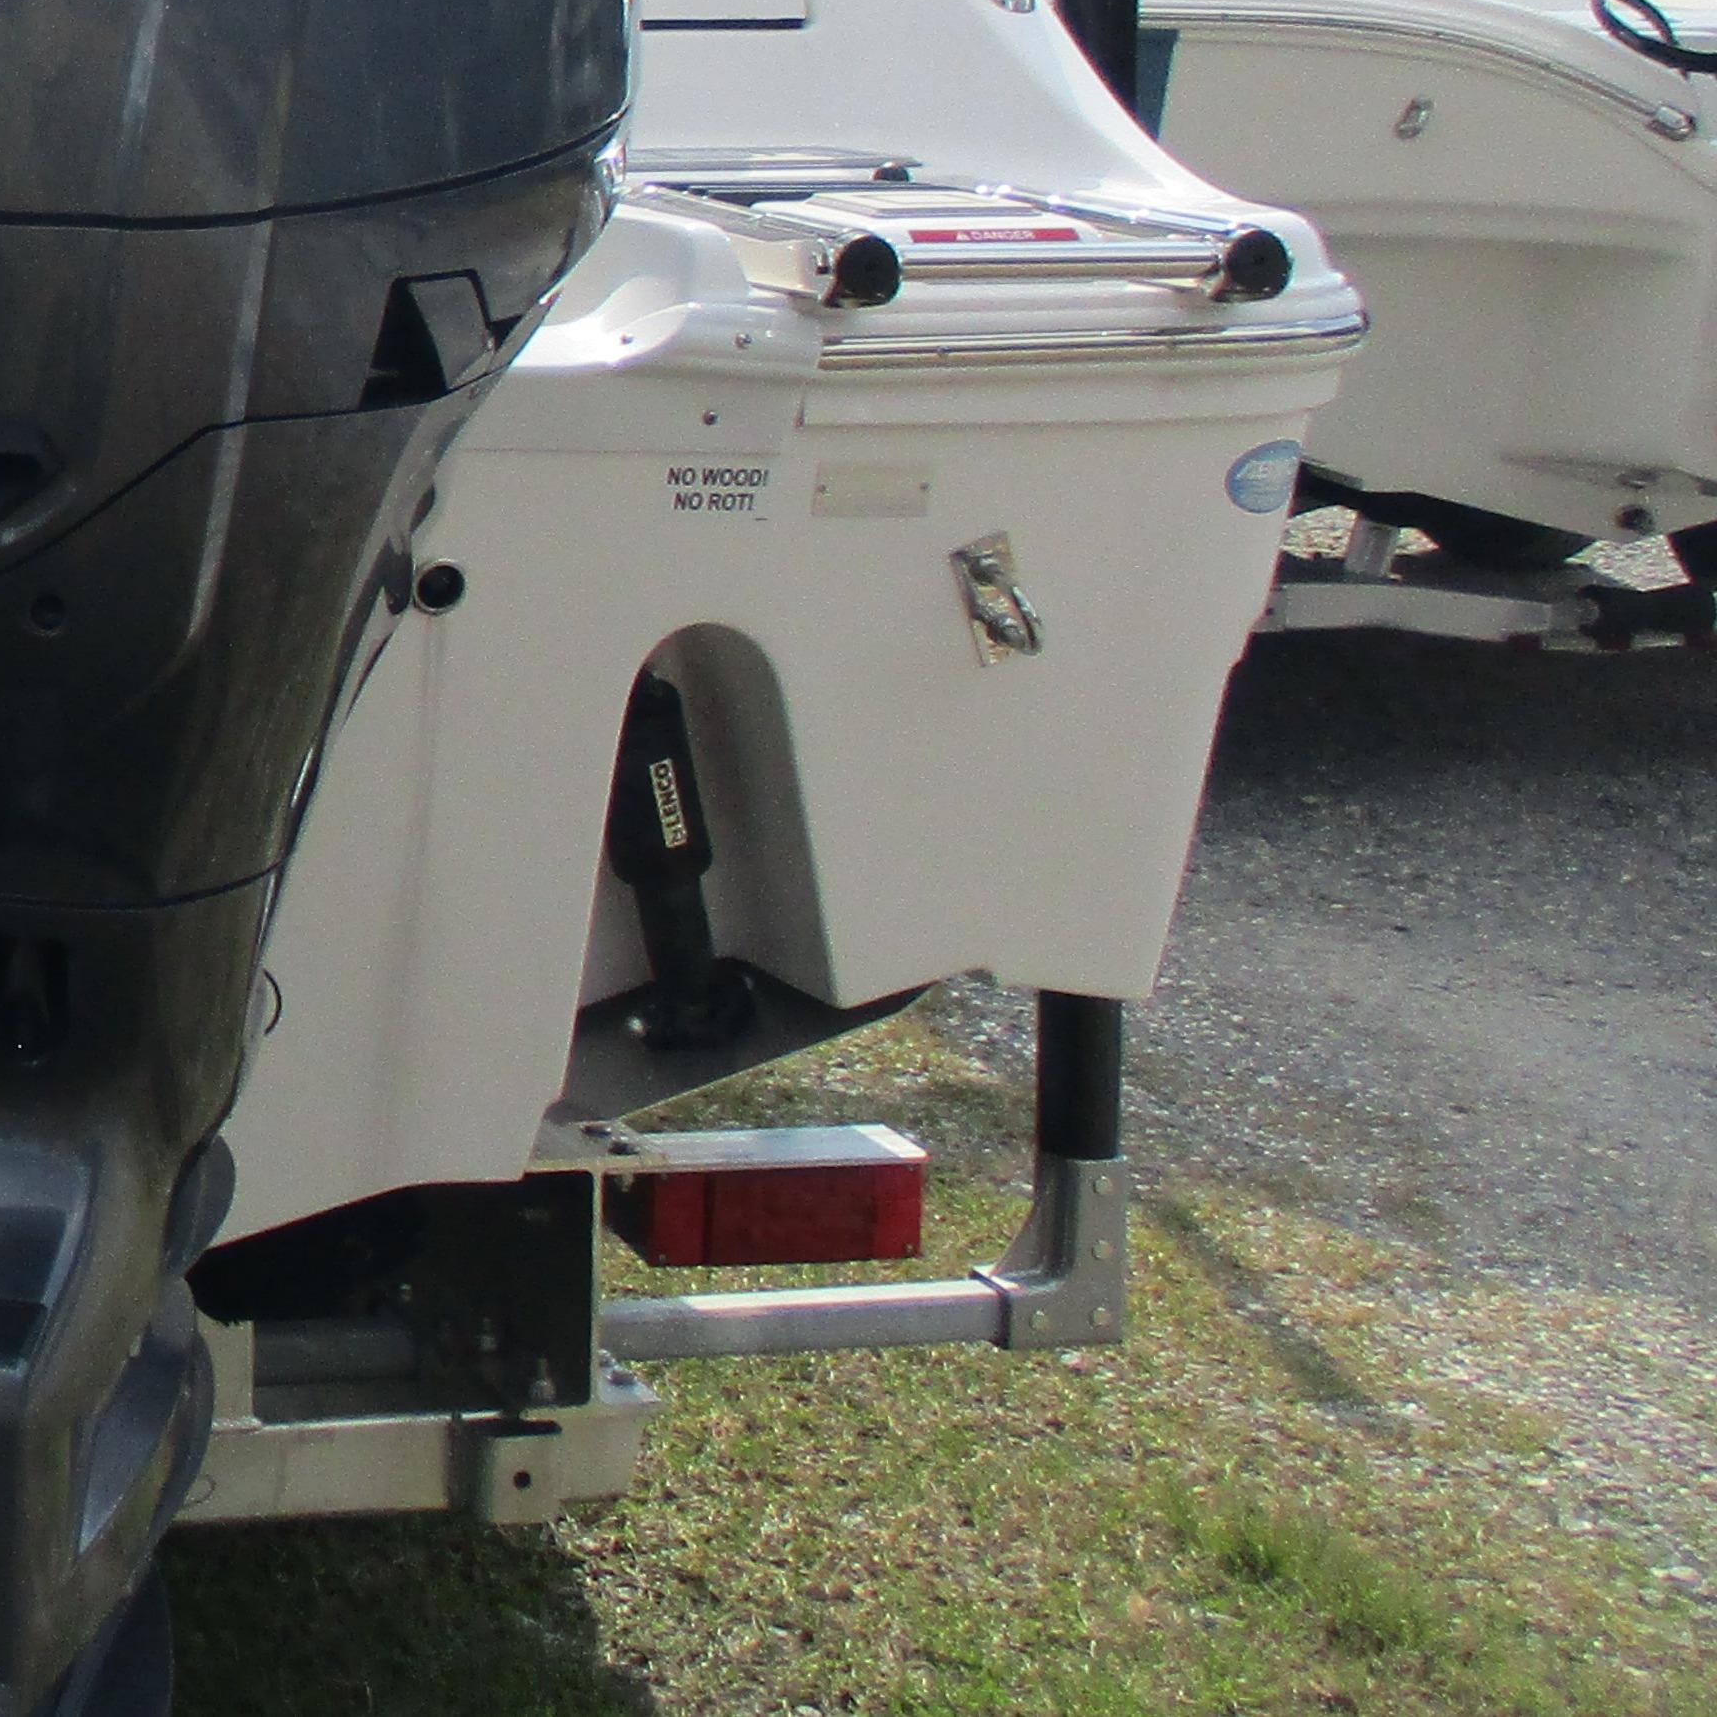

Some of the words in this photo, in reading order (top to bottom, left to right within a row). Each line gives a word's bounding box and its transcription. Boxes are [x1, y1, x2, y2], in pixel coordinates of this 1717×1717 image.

[970, 230, 1036, 241] DANGER
[667, 468, 696, 486] NO
[702, 468, 769, 487] WOOD!
[673, 492, 703, 510] NO
[708, 492, 755, 511] ROT!
[653, 762, 682, 829] LENCO
